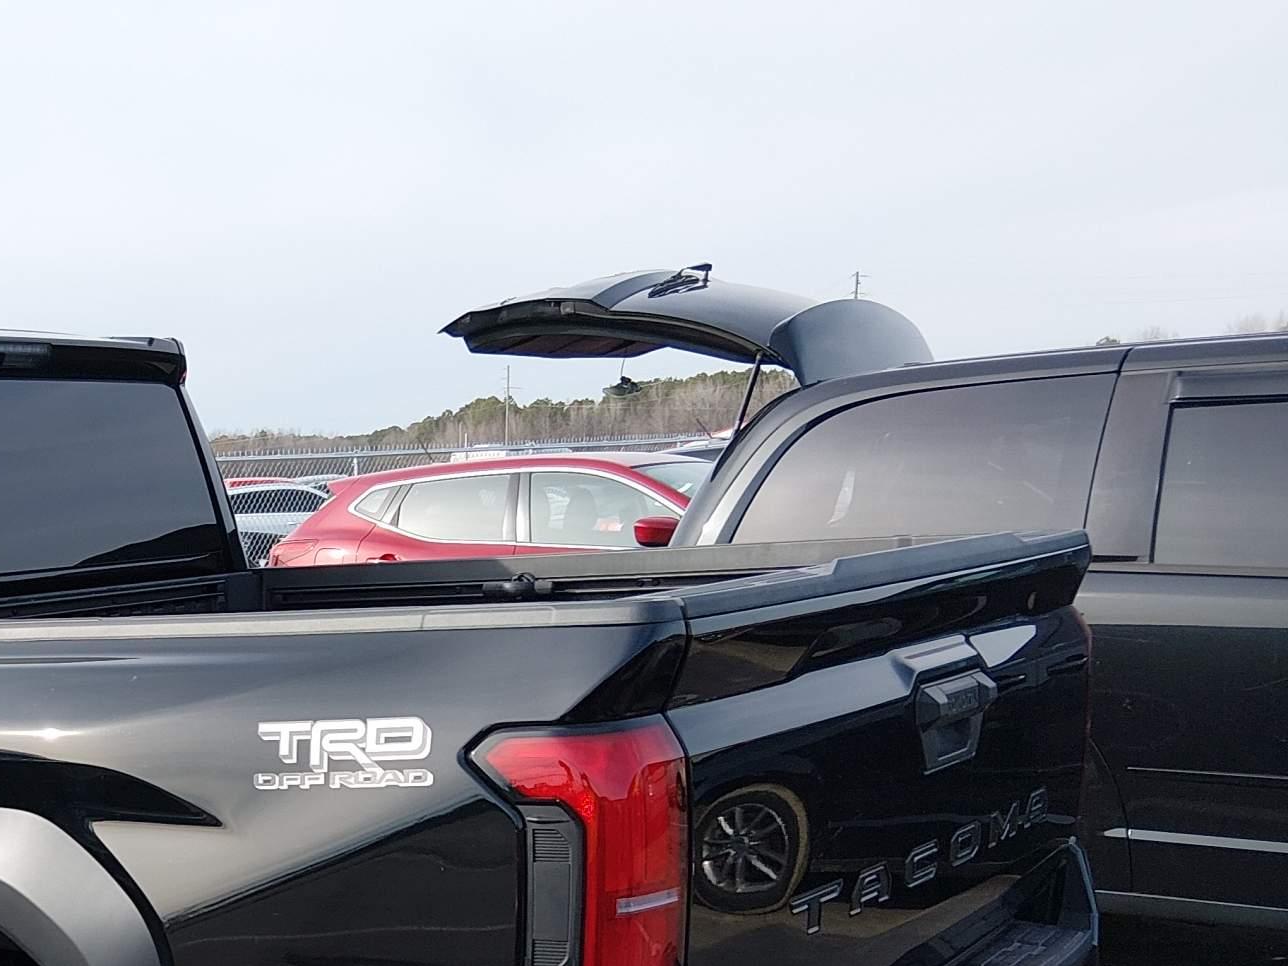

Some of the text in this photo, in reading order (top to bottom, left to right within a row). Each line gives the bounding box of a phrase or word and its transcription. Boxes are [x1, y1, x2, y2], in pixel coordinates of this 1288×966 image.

[258, 716, 433, 774] TRD
[253, 768, 434, 790] OFF ROAD
[789, 785, 1049, 936] TACOMA
